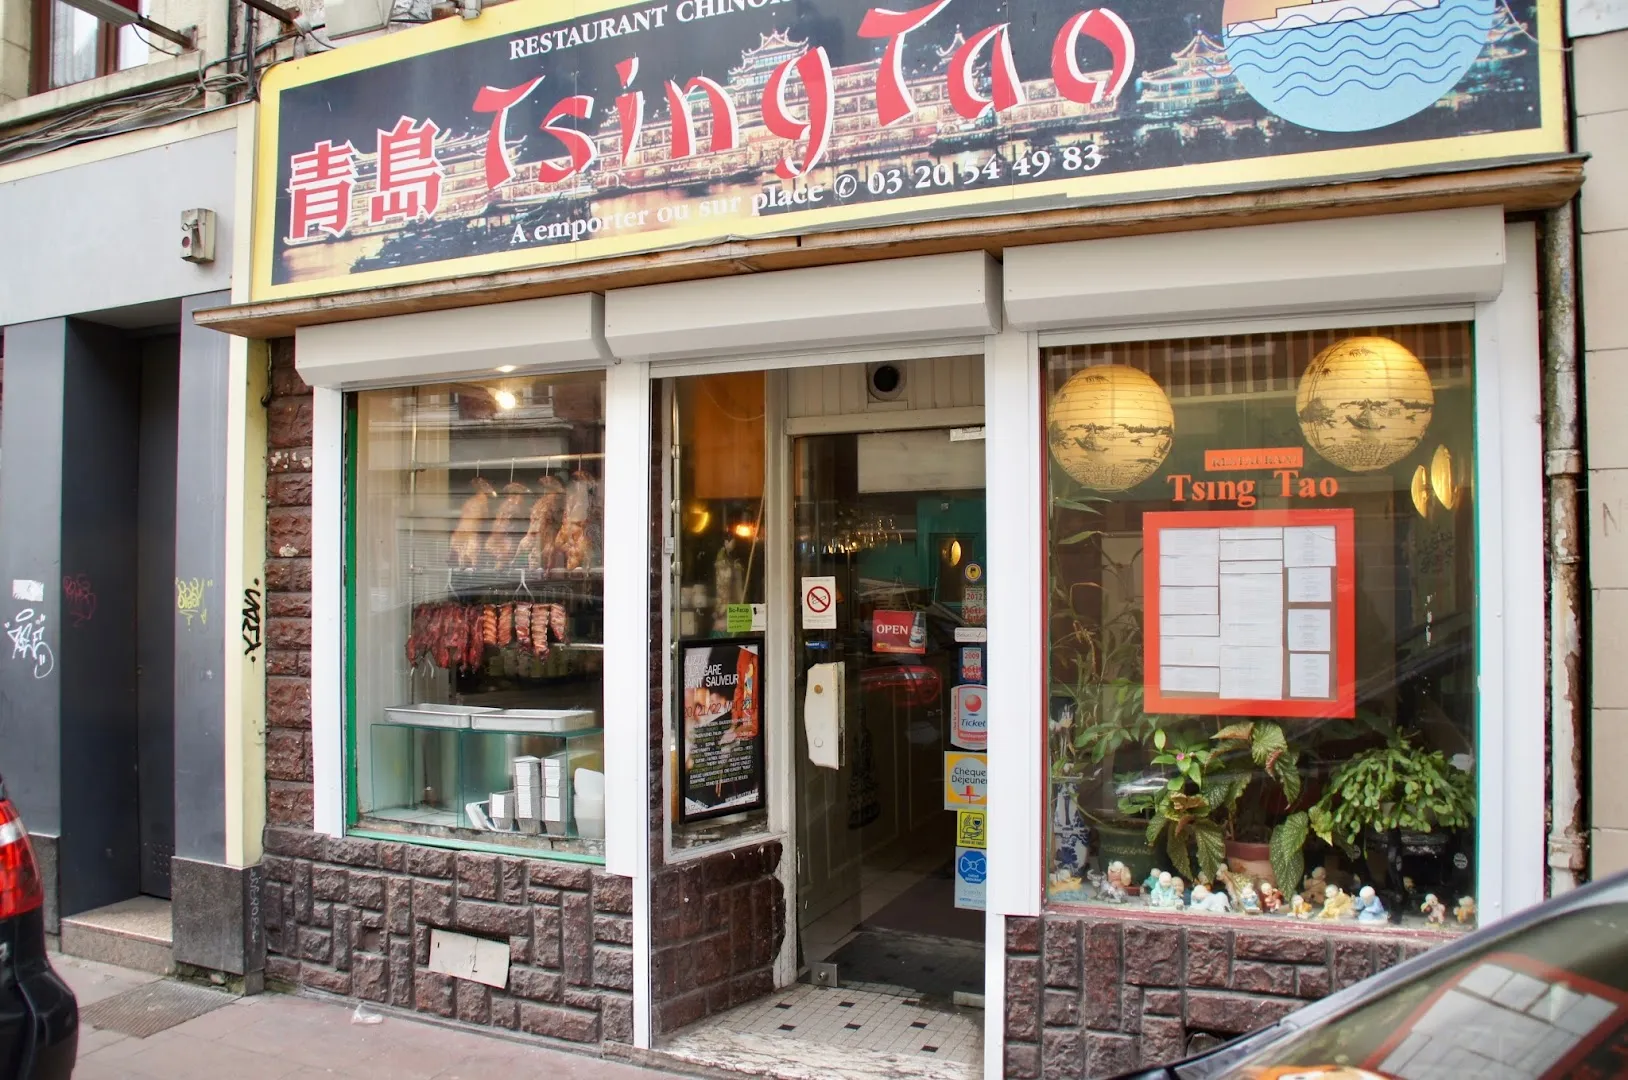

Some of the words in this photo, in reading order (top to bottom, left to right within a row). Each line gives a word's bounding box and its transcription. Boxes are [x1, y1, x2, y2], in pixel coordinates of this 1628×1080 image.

[509, 10, 666, 61] RESTAURANT
[472, 46, 836, 190] Tsing
[856, 0, 1136, 127] Tao
[284, 115, 446, 246] 青島
[511, 224, 528, 244] A
[533, 208, 650, 241] emporter
[656, 202, 689, 224] ou
[699, 196, 742, 218] sur
[750, 184, 824, 216] place
[867, 169, 903, 196] 03
[914, 161, 951, 191] 20
[962, 155, 1000, 185] 54
[1012, 148, 1051, 179] 49
[1061, 144, 1103, 172] 83
[1273, 469, 1339, 498] Tao
[876, 624, 909, 636] OPEN
[703, 663, 723, 677] GARE
[705, 674, 740, 688] SAUVEUR
[961, 718, 986, 728] Ticket
